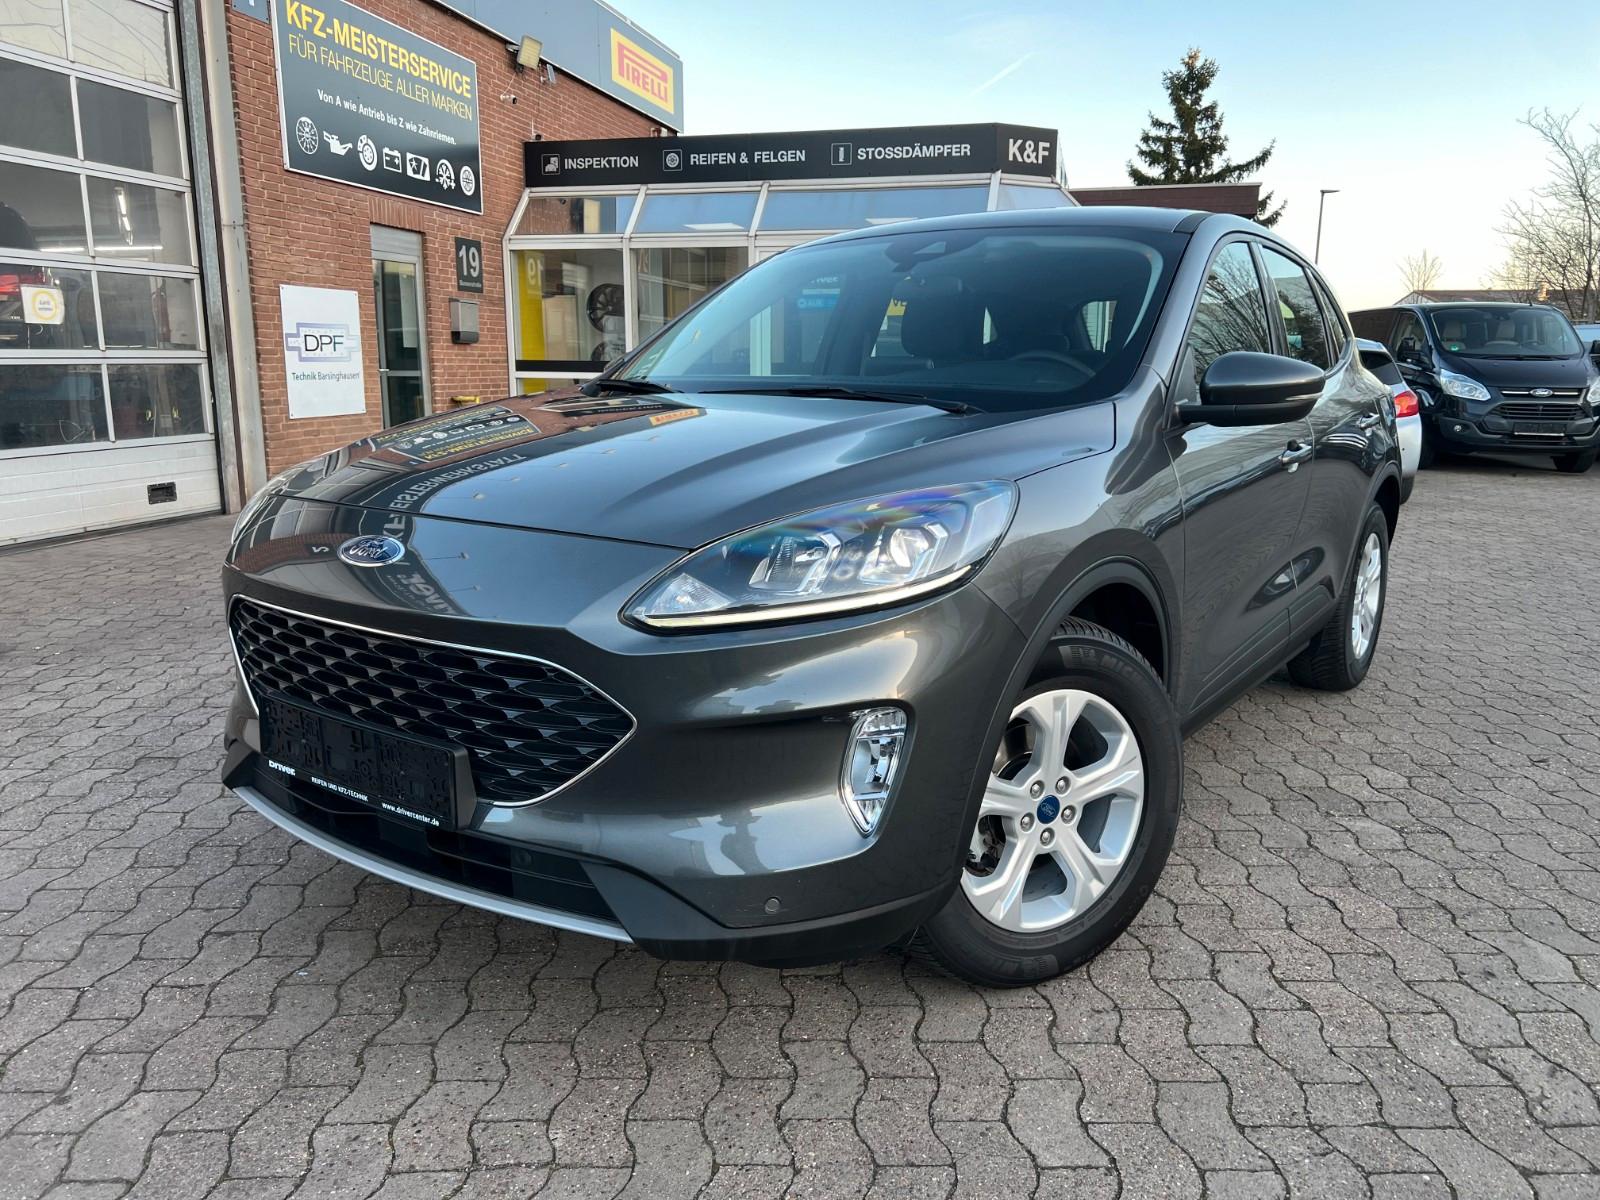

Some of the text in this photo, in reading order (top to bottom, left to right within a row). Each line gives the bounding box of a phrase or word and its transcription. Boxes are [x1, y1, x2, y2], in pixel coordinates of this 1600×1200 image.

[286, 0, 471, 98] KFZ-MEISTERSERVICE
[288, 33, 472, 121] FÜR FAHRZEUGE ALLER MARKEN
[617, 41, 669, 104] PIRELLI
[317, 89, 457, 145] Von A wie Antrieb bis Z wie Zahnriemen.
[564, 156, 640, 170] INSPEKTION
[690, 149, 806, 165] REIFEN & FELGEN
[857, 143, 971, 161] STOSSDÄMPFER
[1008, 138, 1051, 164] K&F
[459, 244, 480, 278] 19
[304, 334, 344, 352] DPF
[292, 371, 360, 382] Technik Barsinghausen
[311, 776, 369, 802] REIFEN UND KFZ-TECHNIK
[381, 802, 440, 827] www.drivercenter.de
